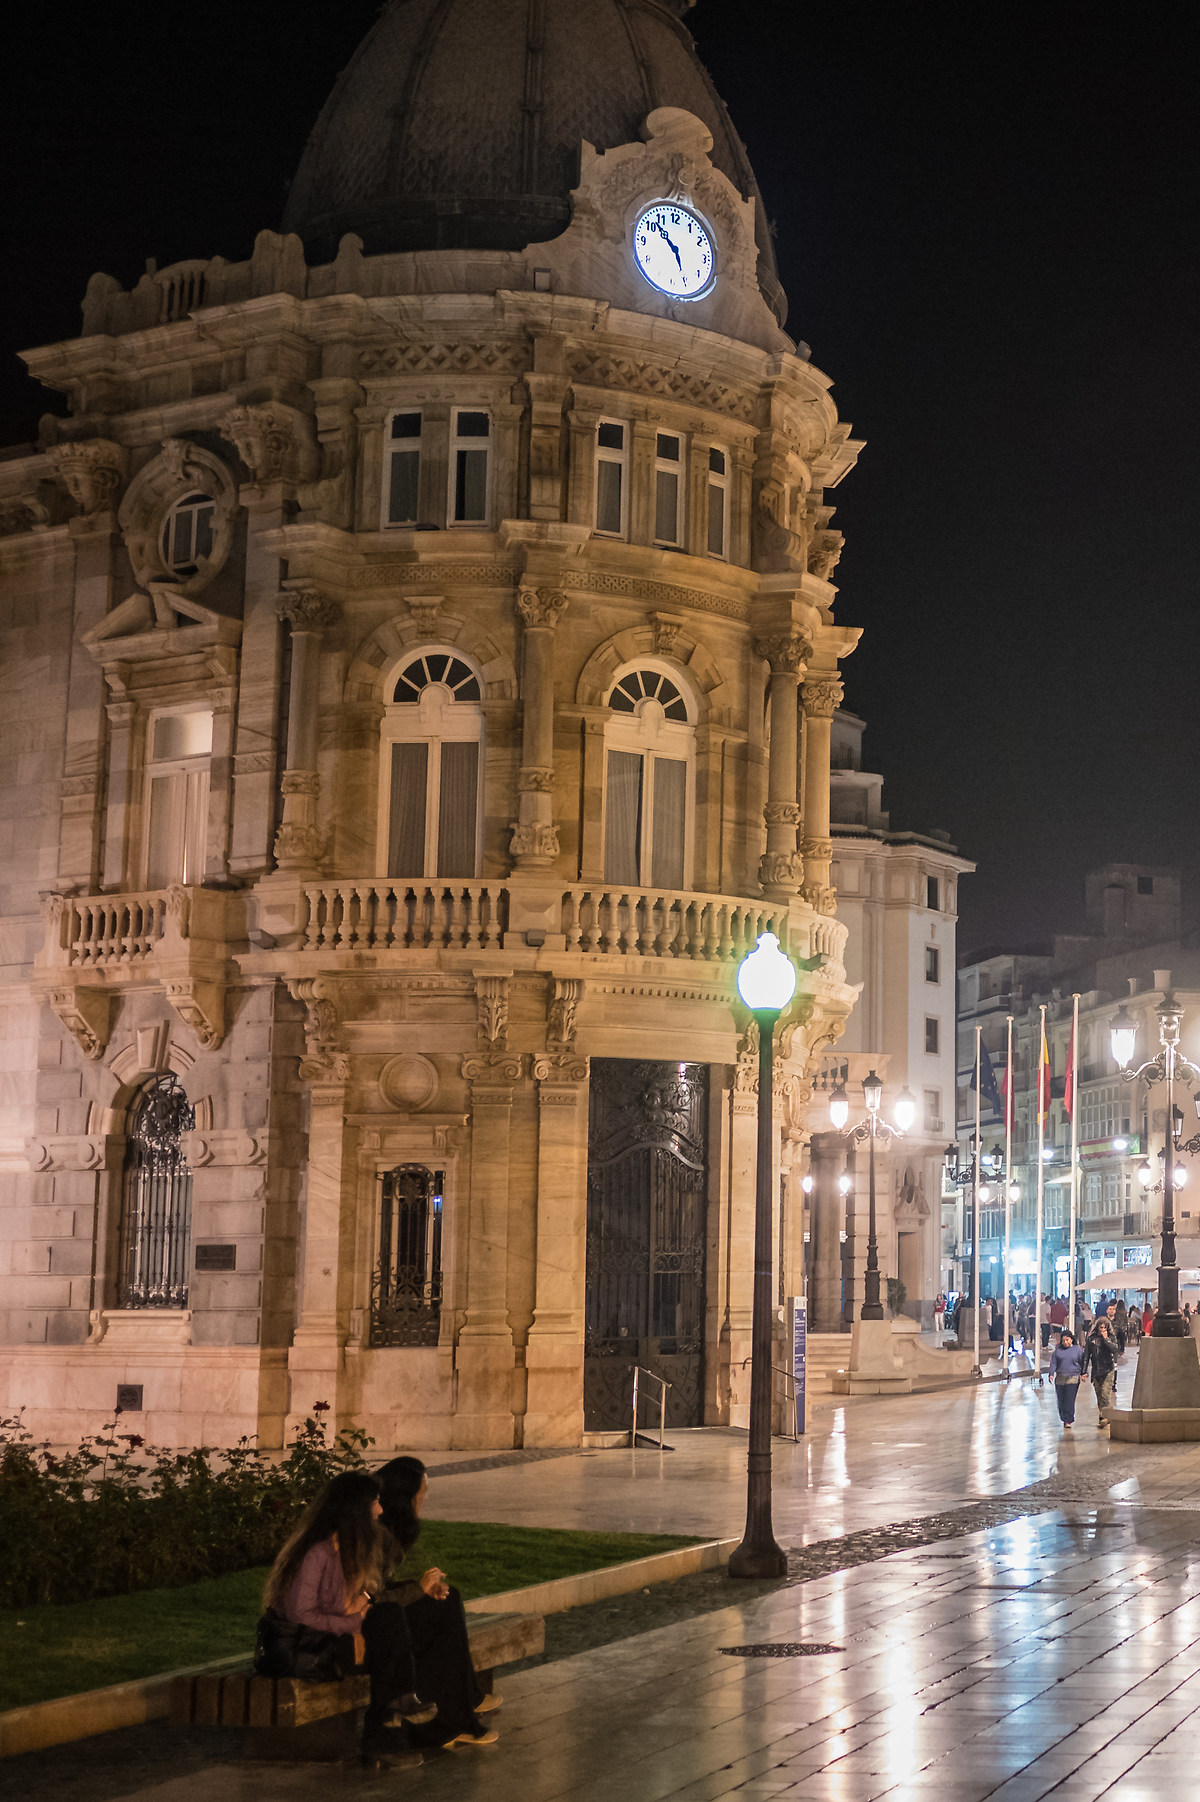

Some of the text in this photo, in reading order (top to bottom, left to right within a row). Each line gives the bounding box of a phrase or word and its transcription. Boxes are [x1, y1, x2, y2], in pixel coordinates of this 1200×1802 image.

[656, 213, 666, 226] 11
[670, 213, 680, 225] 12
[646, 220, 656, 232] 10
[687, 223, 692, 233] 1
[640, 235, 646, 246] 9
[697, 236, 702, 247] 2
[702, 254, 707, 264] 3
